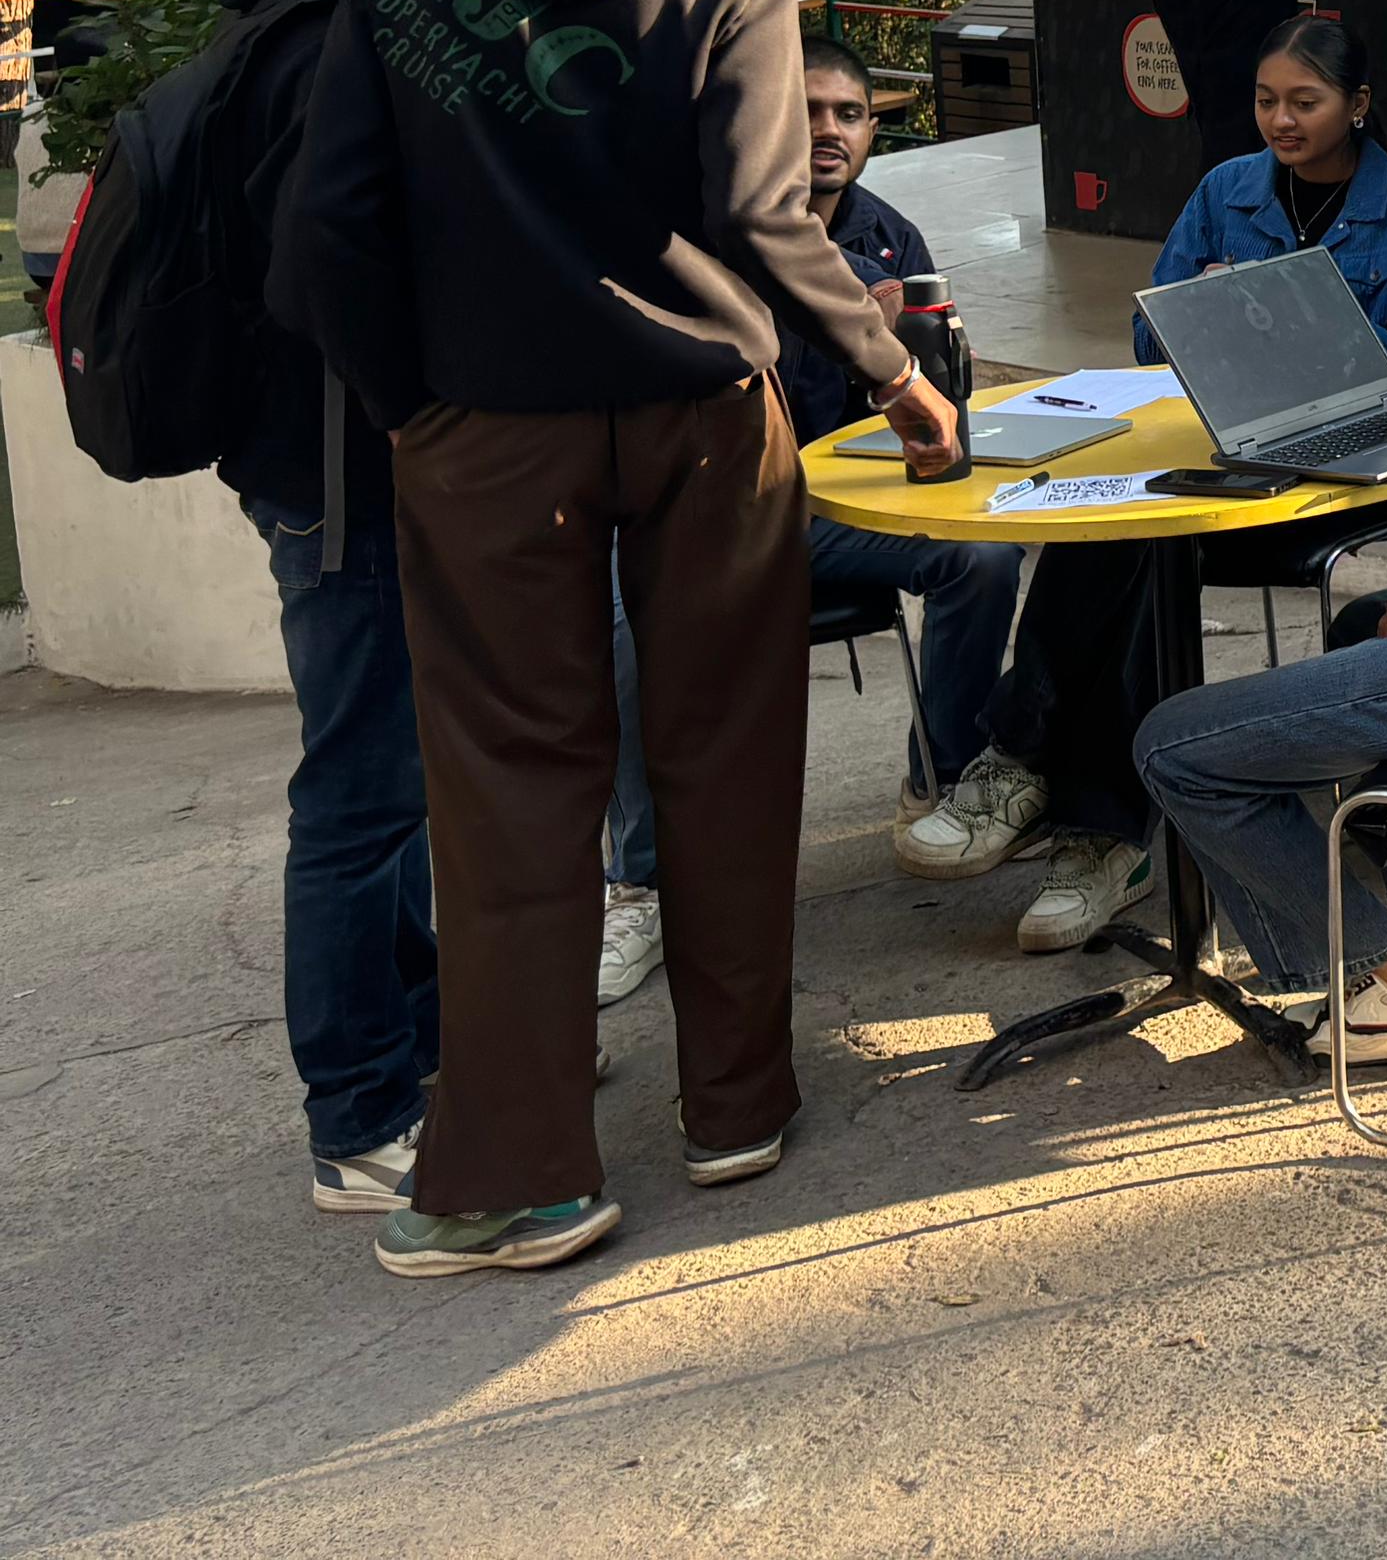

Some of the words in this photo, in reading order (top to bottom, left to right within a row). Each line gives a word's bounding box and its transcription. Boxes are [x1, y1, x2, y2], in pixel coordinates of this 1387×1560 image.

[1135, 41, 1154, 54] YOUR
[1136, 57, 1151, 71] FOR
[373, 28, 471, 115] CRUISE
[1137, 76, 1155, 89] ENDS
